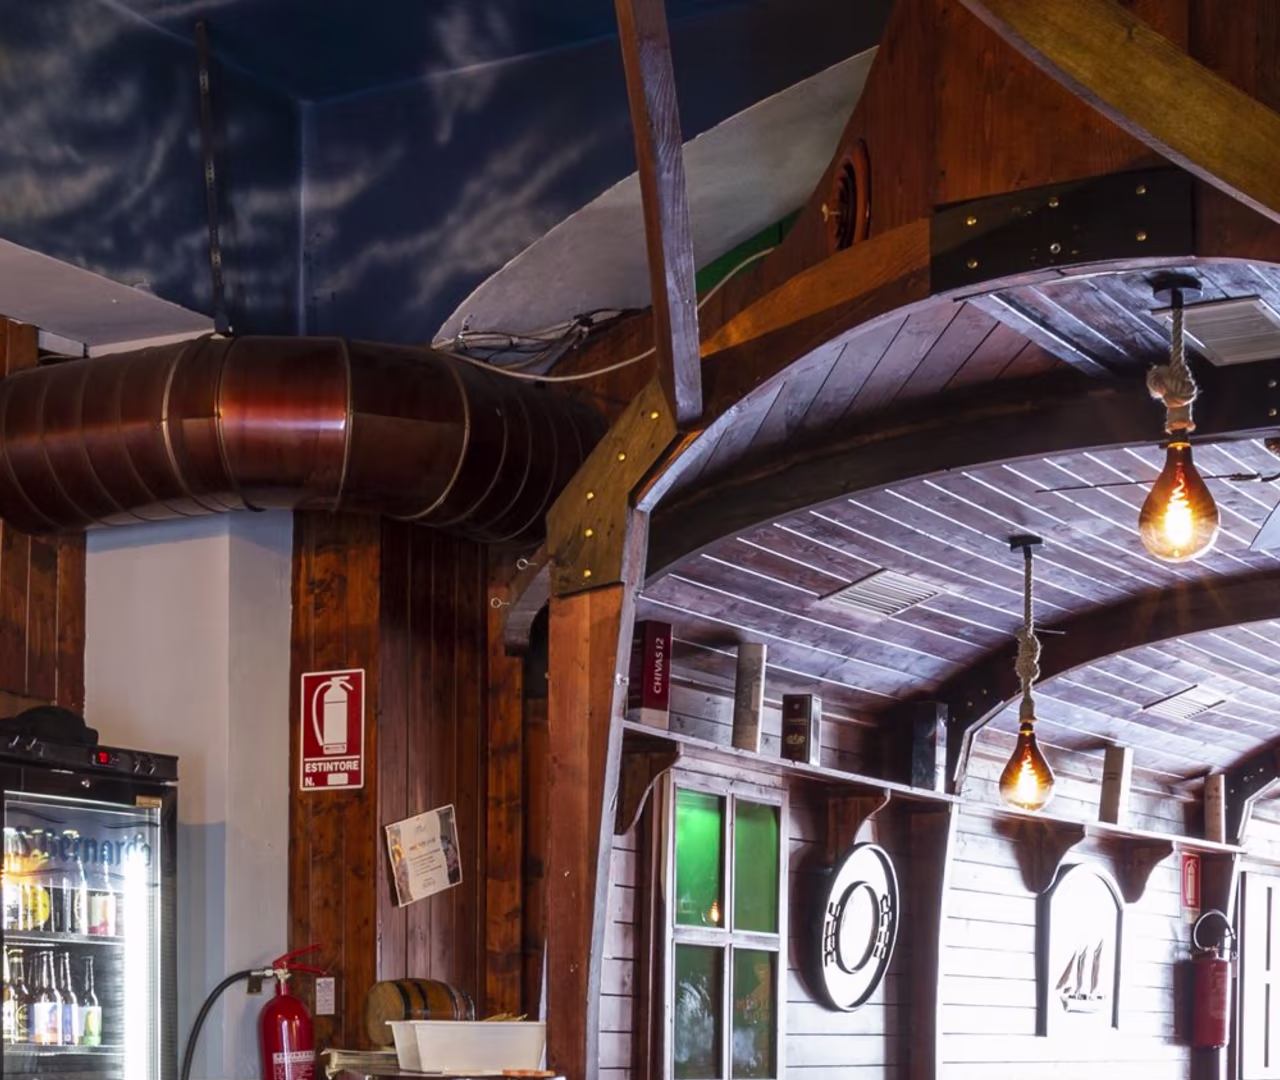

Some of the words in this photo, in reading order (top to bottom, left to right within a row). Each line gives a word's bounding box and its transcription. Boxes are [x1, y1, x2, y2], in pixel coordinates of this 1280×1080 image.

[652, 651, 664, 694] CHIVAS
[305, 760, 359, 773] ESTINTORE
[305, 776, 315, 786] N.
